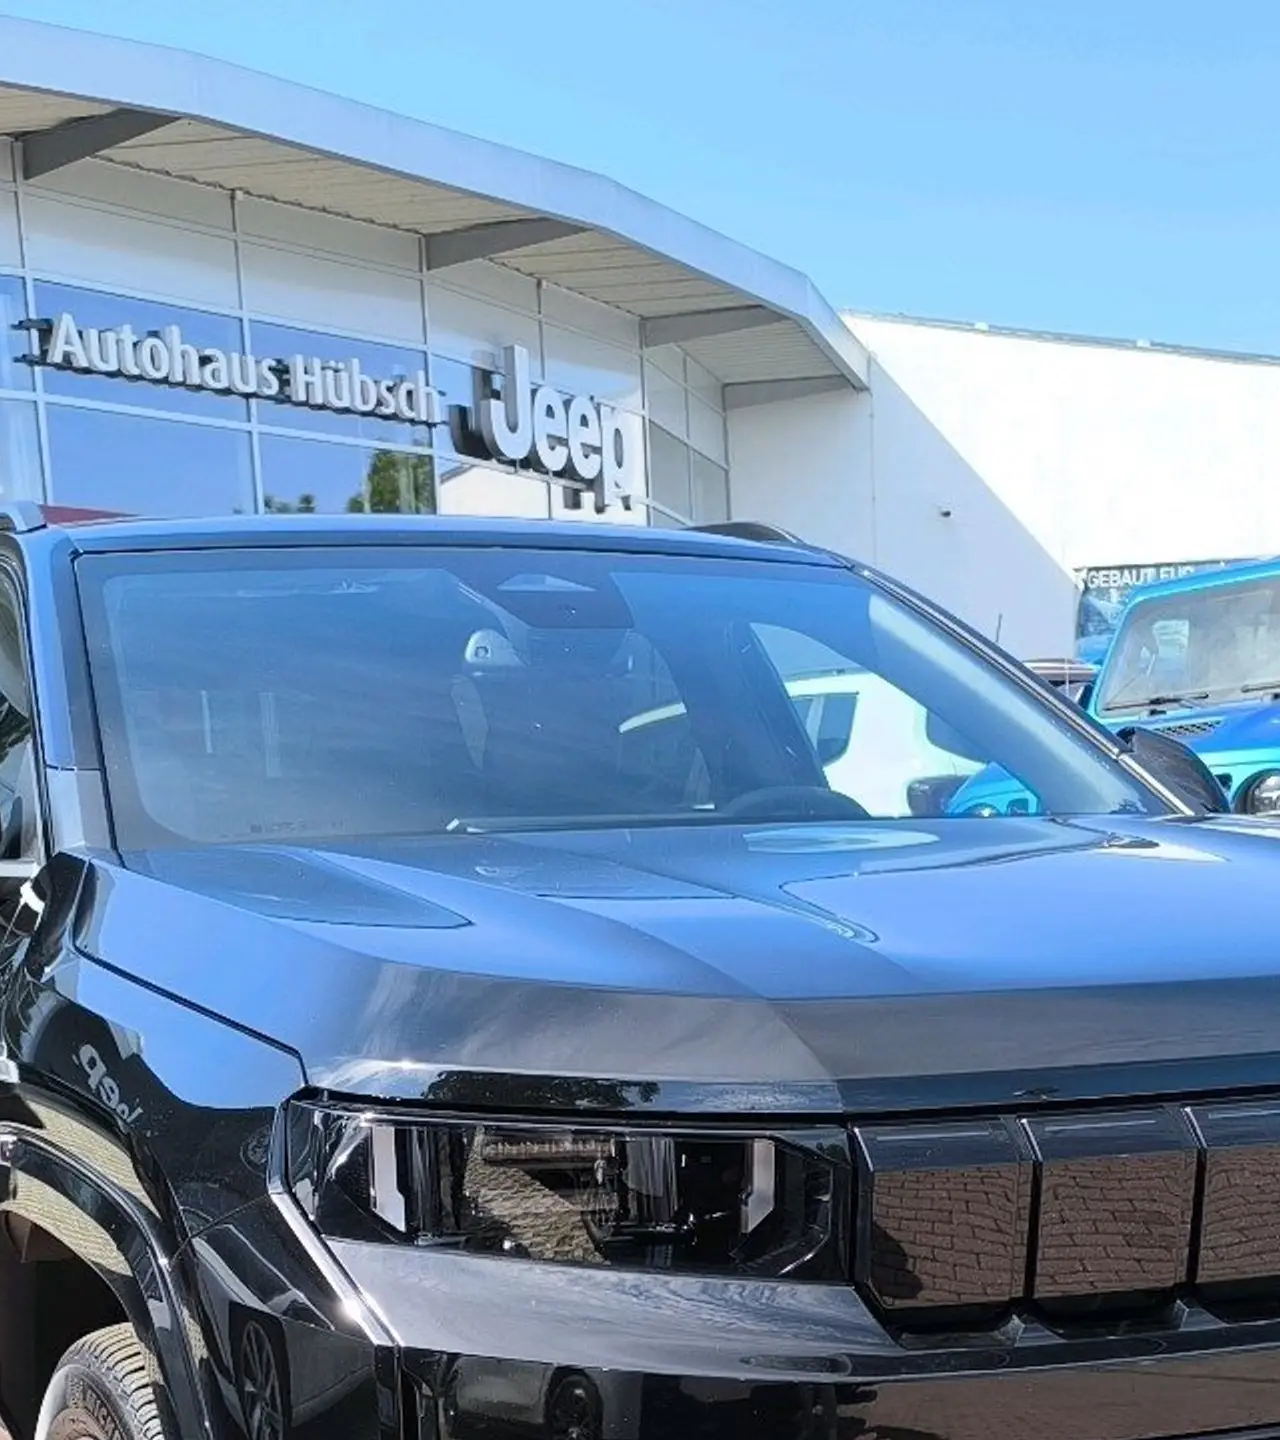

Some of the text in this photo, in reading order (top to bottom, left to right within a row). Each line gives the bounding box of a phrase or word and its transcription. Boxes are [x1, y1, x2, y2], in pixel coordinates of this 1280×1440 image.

[47, 312, 443, 424] Autohaus Hübsch
[483, 344, 639, 505] Jeep
